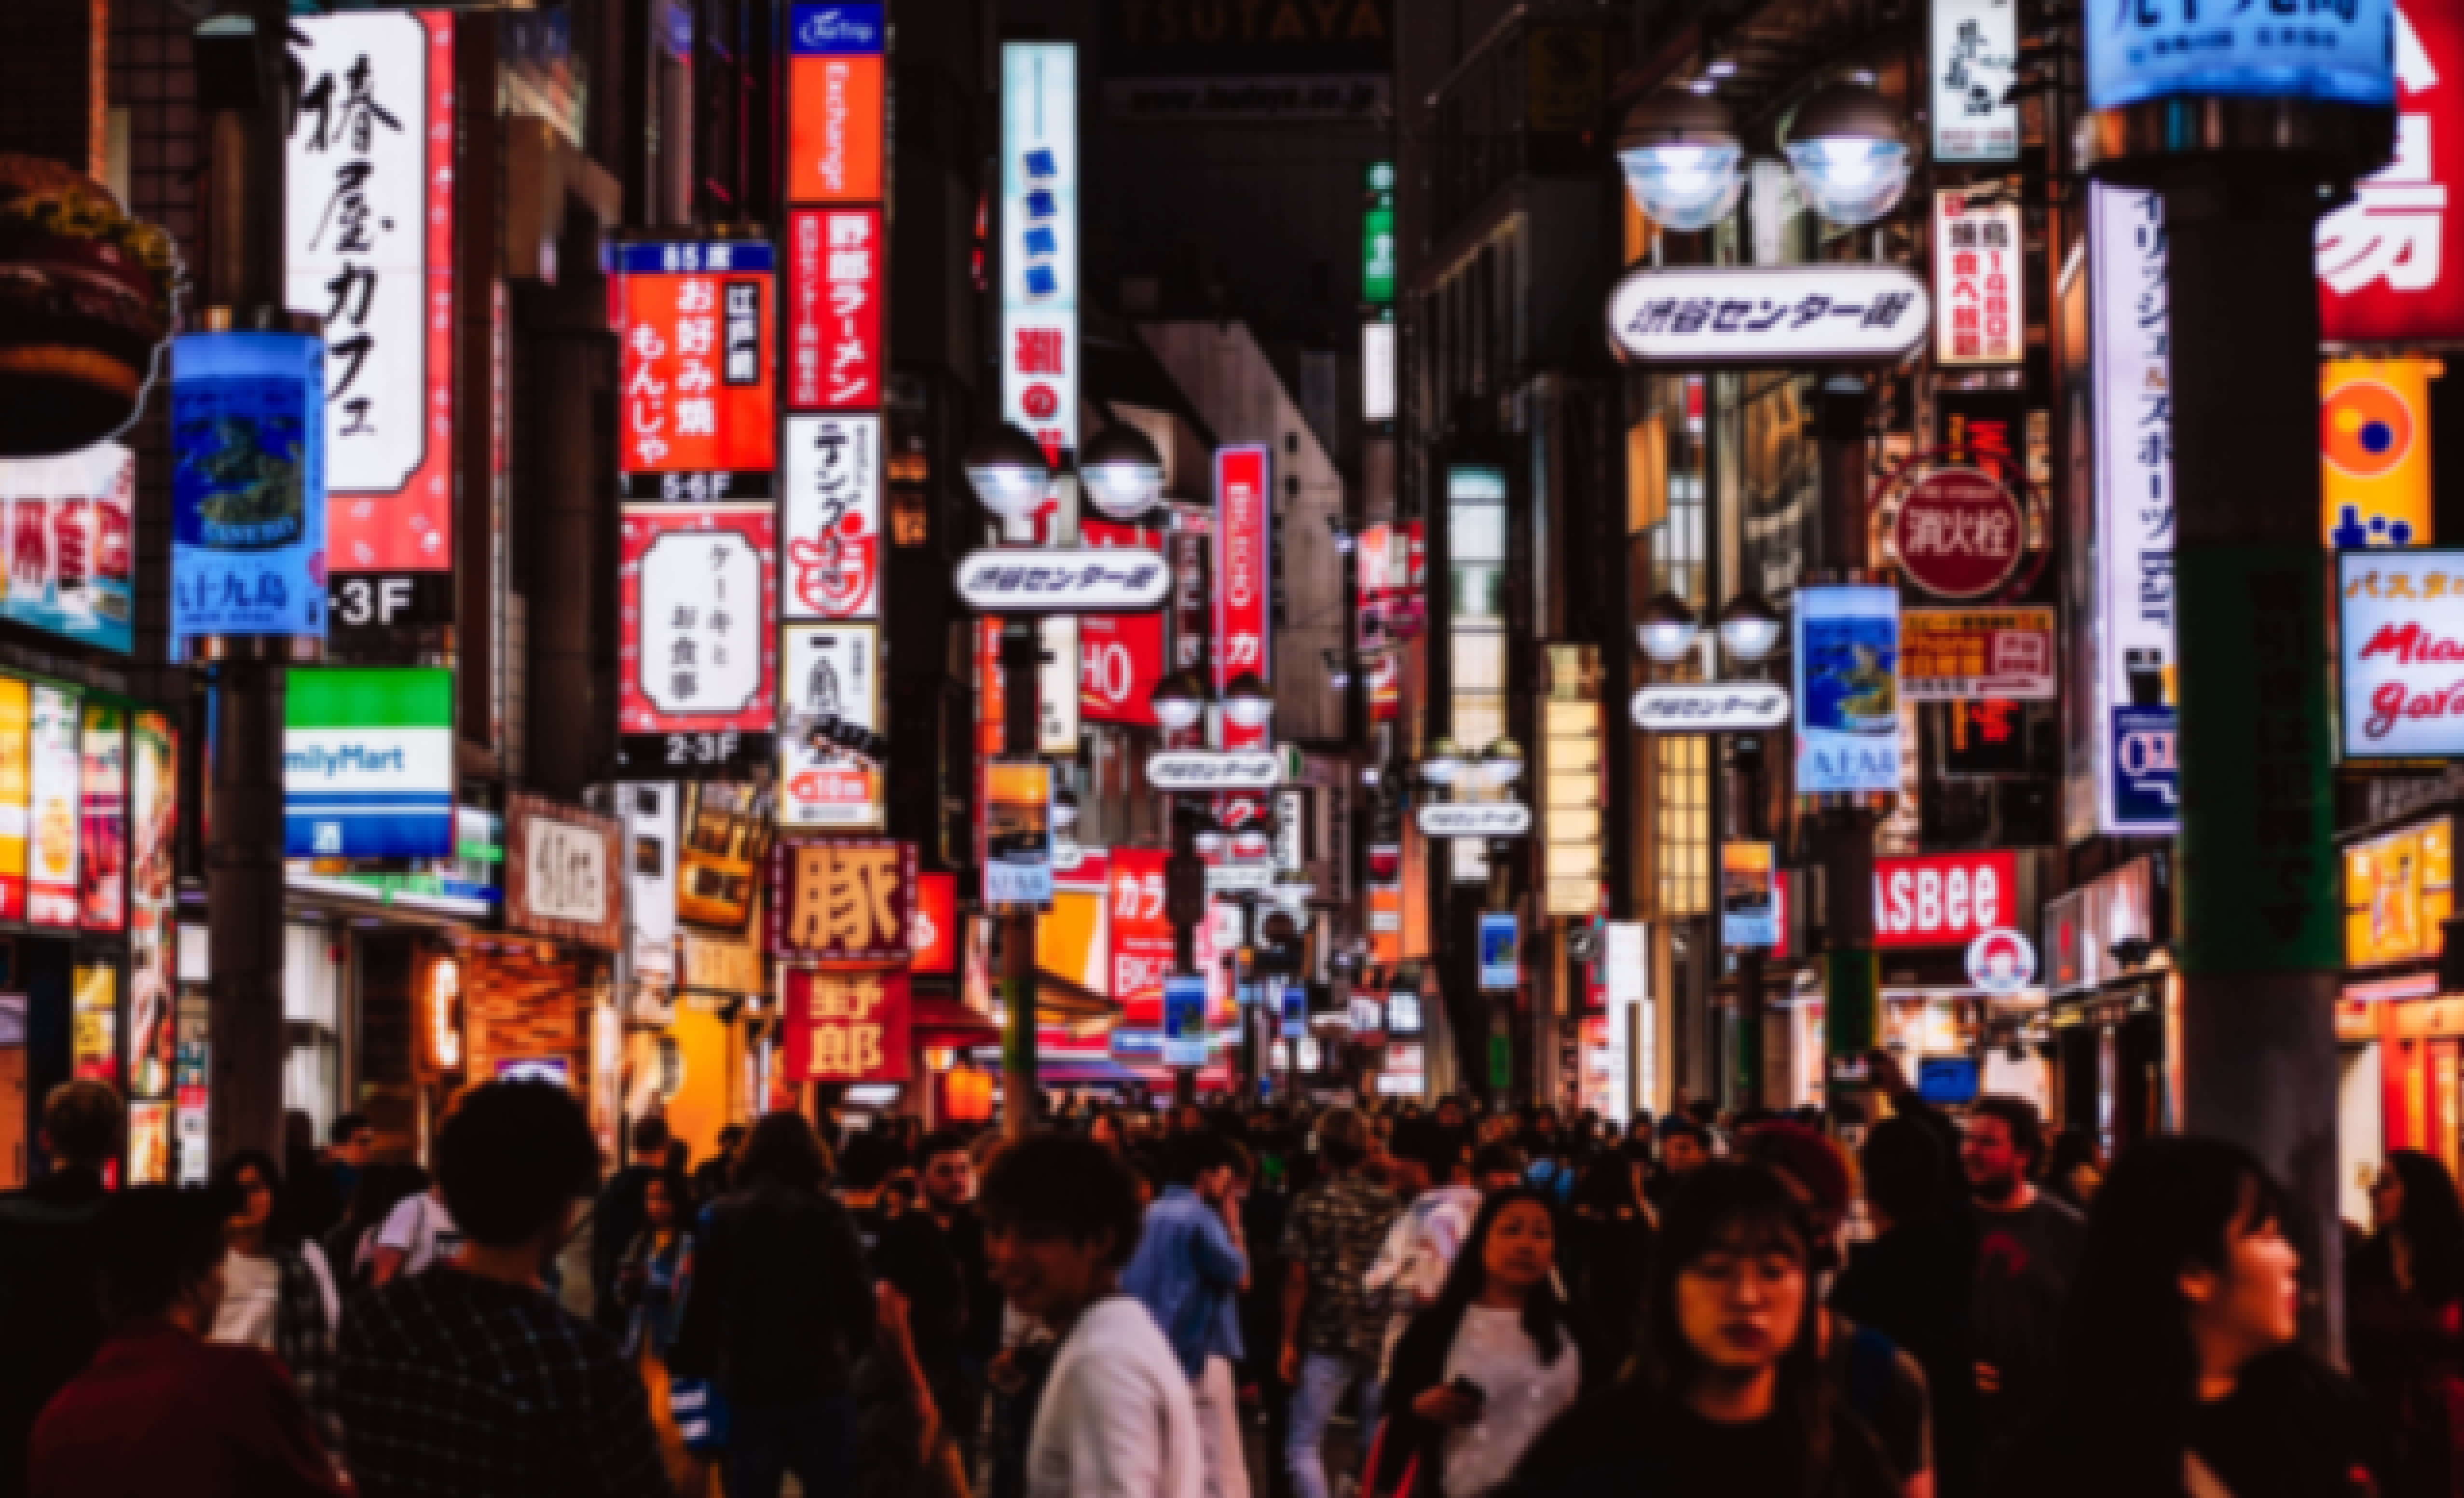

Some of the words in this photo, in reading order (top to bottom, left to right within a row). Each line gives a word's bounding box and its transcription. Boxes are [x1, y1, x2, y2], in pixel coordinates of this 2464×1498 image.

[1126, 0, 1384, 41] TSUTAYA
[820, 63, 849, 192] Exchange
[300, 53, 403, 437] 椿屋カフェ
[675, 281, 714, 436] お好み焼
[828, 214, 870, 404] 野郎ラーメン
[1628, 292, 1914, 335] 渋谷センター街
[629, 323, 669, 467] もんじゃ
[967, 563, 1161, 593] 渋谷センター街
[1908, 507, 2013, 558] 消火栓
[671, 605, 698, 702] お食事
[710, 545, 731, 667] ケーキと
[789, 847, 900, 949] 豚
[808, 971, 882, 1075] 野郎
